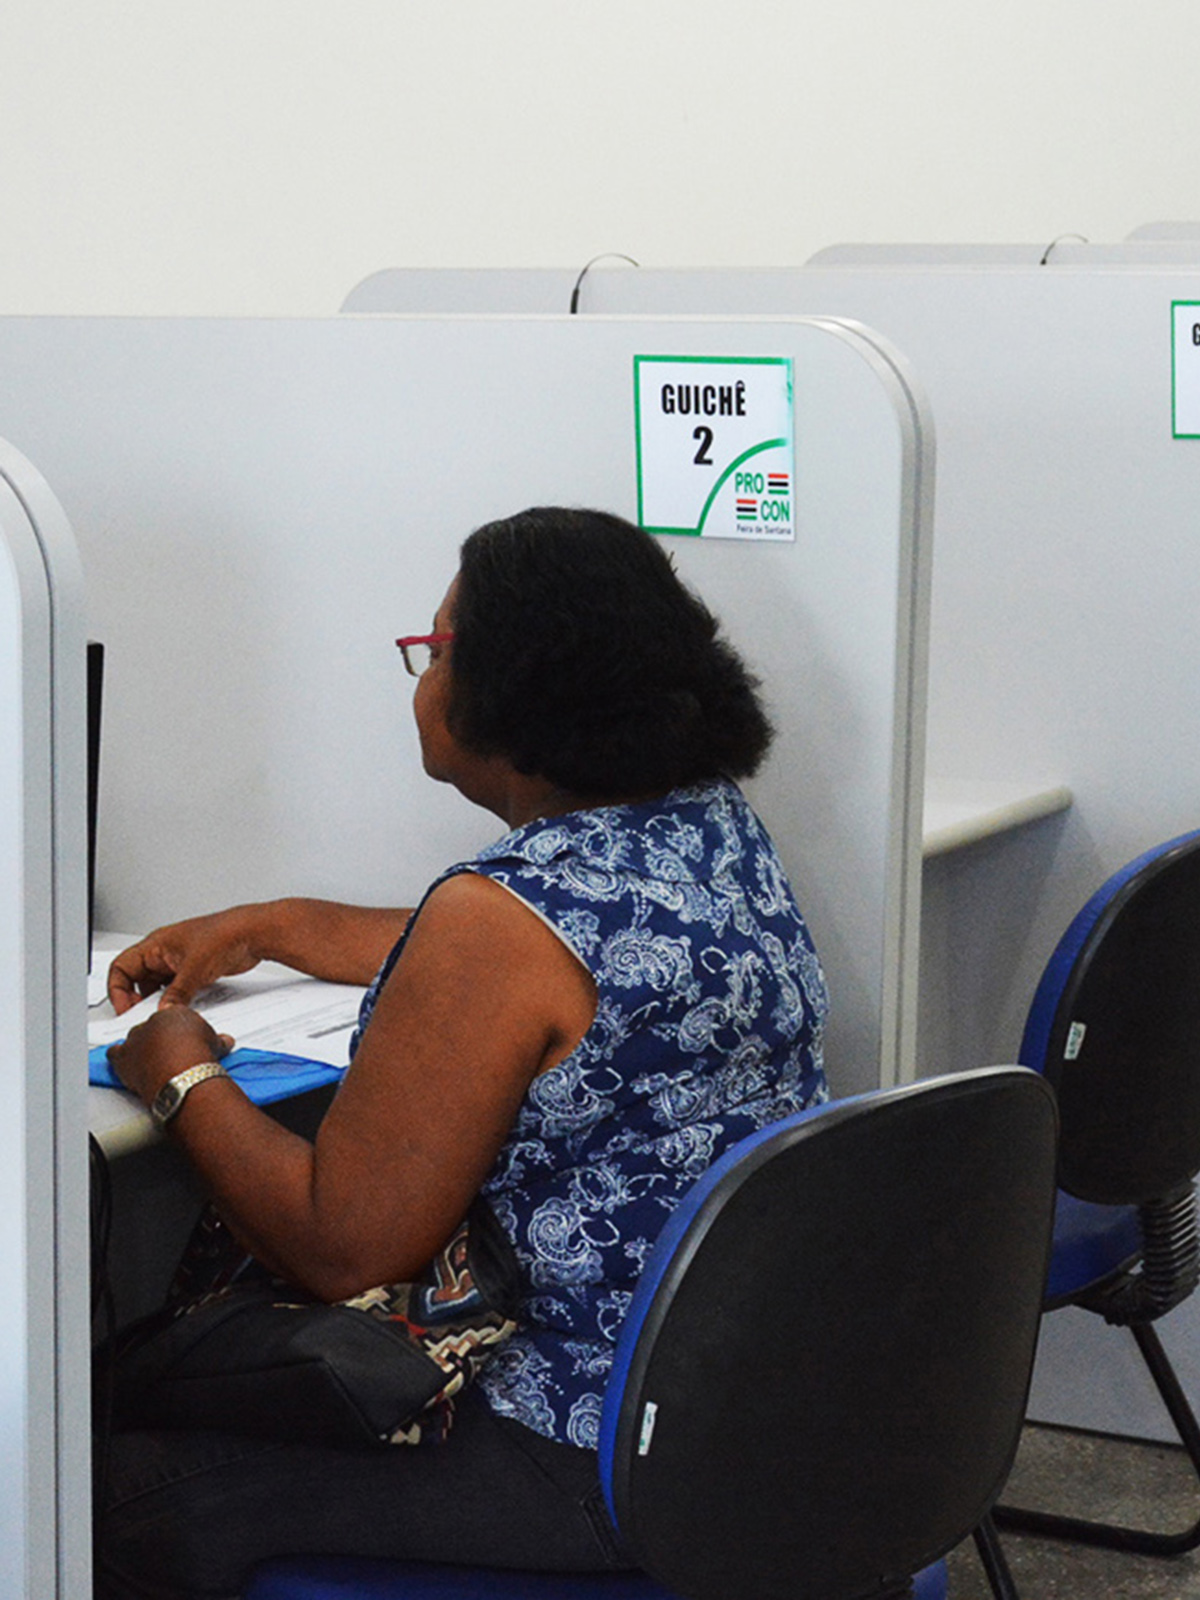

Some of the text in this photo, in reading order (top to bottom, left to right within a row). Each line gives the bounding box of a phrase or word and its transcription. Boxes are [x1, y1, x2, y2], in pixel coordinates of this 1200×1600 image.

[661, 380, 746, 416] GUICHÊ
[693, 425, 714, 465] 2
[734, 472, 764, 494] PRO
[760, 500, 790, 521] CON
